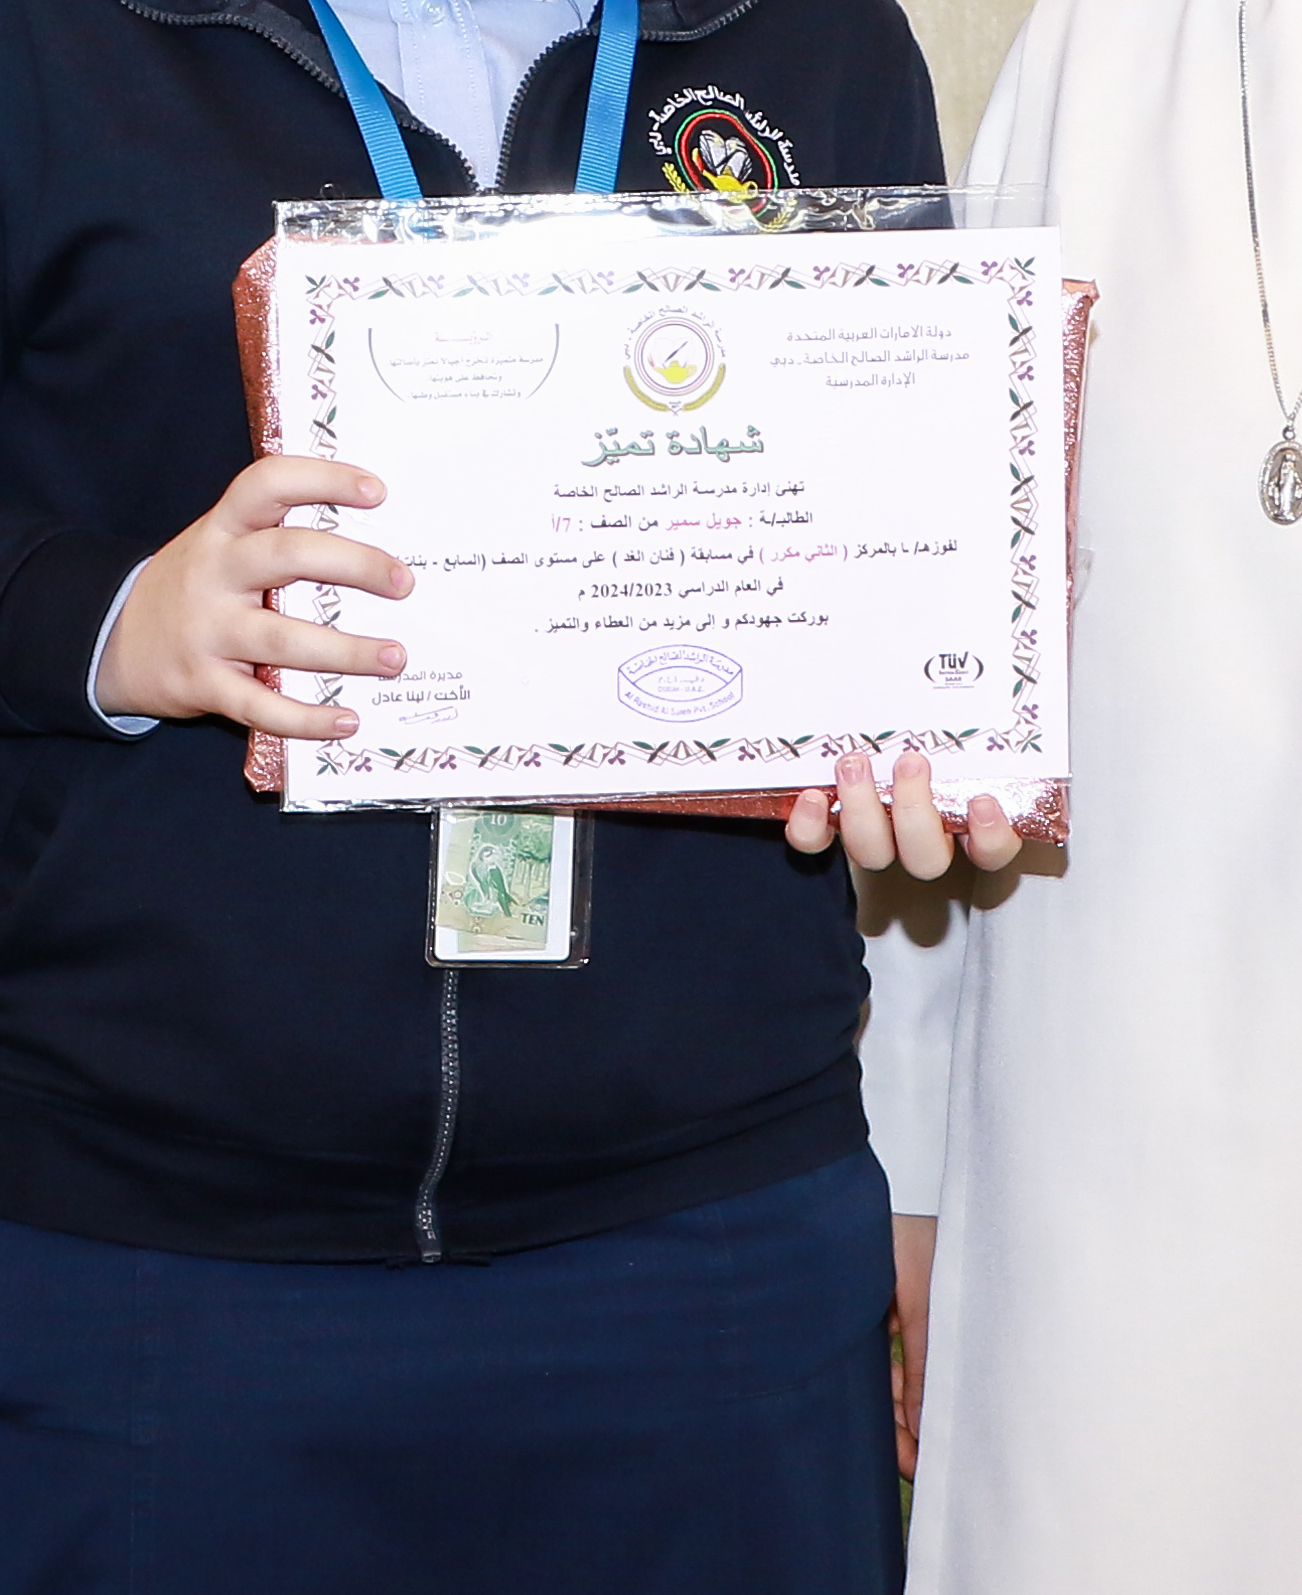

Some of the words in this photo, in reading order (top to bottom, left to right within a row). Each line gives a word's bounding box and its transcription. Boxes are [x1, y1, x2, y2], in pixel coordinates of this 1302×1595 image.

[787, 328, 836, 342] المتحدة
[838, 327, 877, 342] العربية
[926, 325, 952, 340] دولة
[803, 352, 848, 364] الخاصة
[851, 351, 890, 366] الصالح
[894, 349, 928, 364] الراشد
[931, 349, 970, 362] مدرسة
[826, 374, 878, 389] المدرسية
[665, 424, 765, 463] شهادة
[553, 483, 598, 498] الخاصة
[603, 485, 645, 503] الصالح
[650, 483, 688, 499] الراشد
[692, 481, 737, 498] مدرسة
[742, 481, 771, 497] إدارة
[591, 514, 632, 529] الصف
[638, 515, 659, 531] من
[665, 518, 700, 531] سمير
[706, 512, 742, 530] جويل
[624, 549, 644, 563] الغد
[650, 547, 675, 564] فنان
[691, 546, 733, 562] مسابقة
[737, 545, 754, 564] في
[771, 546, 801, 563] مكرر
[804, 543, 838, 562] الثاني
[854, 542, 896, 558] بالمركز
[492, 553, 528, 566] الصف
[534, 552, 578, 567] مستوى
[582, 551, 605, 568] على
[591, 582, 673, 599] 2024/2023
[678, 580, 729, 599] الدراسي
[734, 579, 761, 597] العام
[766, 576, 784, 596] في
[546, 616, 590, 634] والتميز
[594, 614, 634, 629] العطاء
[638, 614, 658, 631] من
[663, 614, 691, 630] مزيد
[695, 612, 716, 632] إلى
[721, 616, 730, 629] و
[734, 612, 782, 630] جهودكم
[787, 611, 829, 626] بوركت
[429, 671, 463, 682] مديرة
[372, 691, 403, 706] عادل
[434, 684, 471, 701] الأخت
[520, 912, 546, 927] TEN
